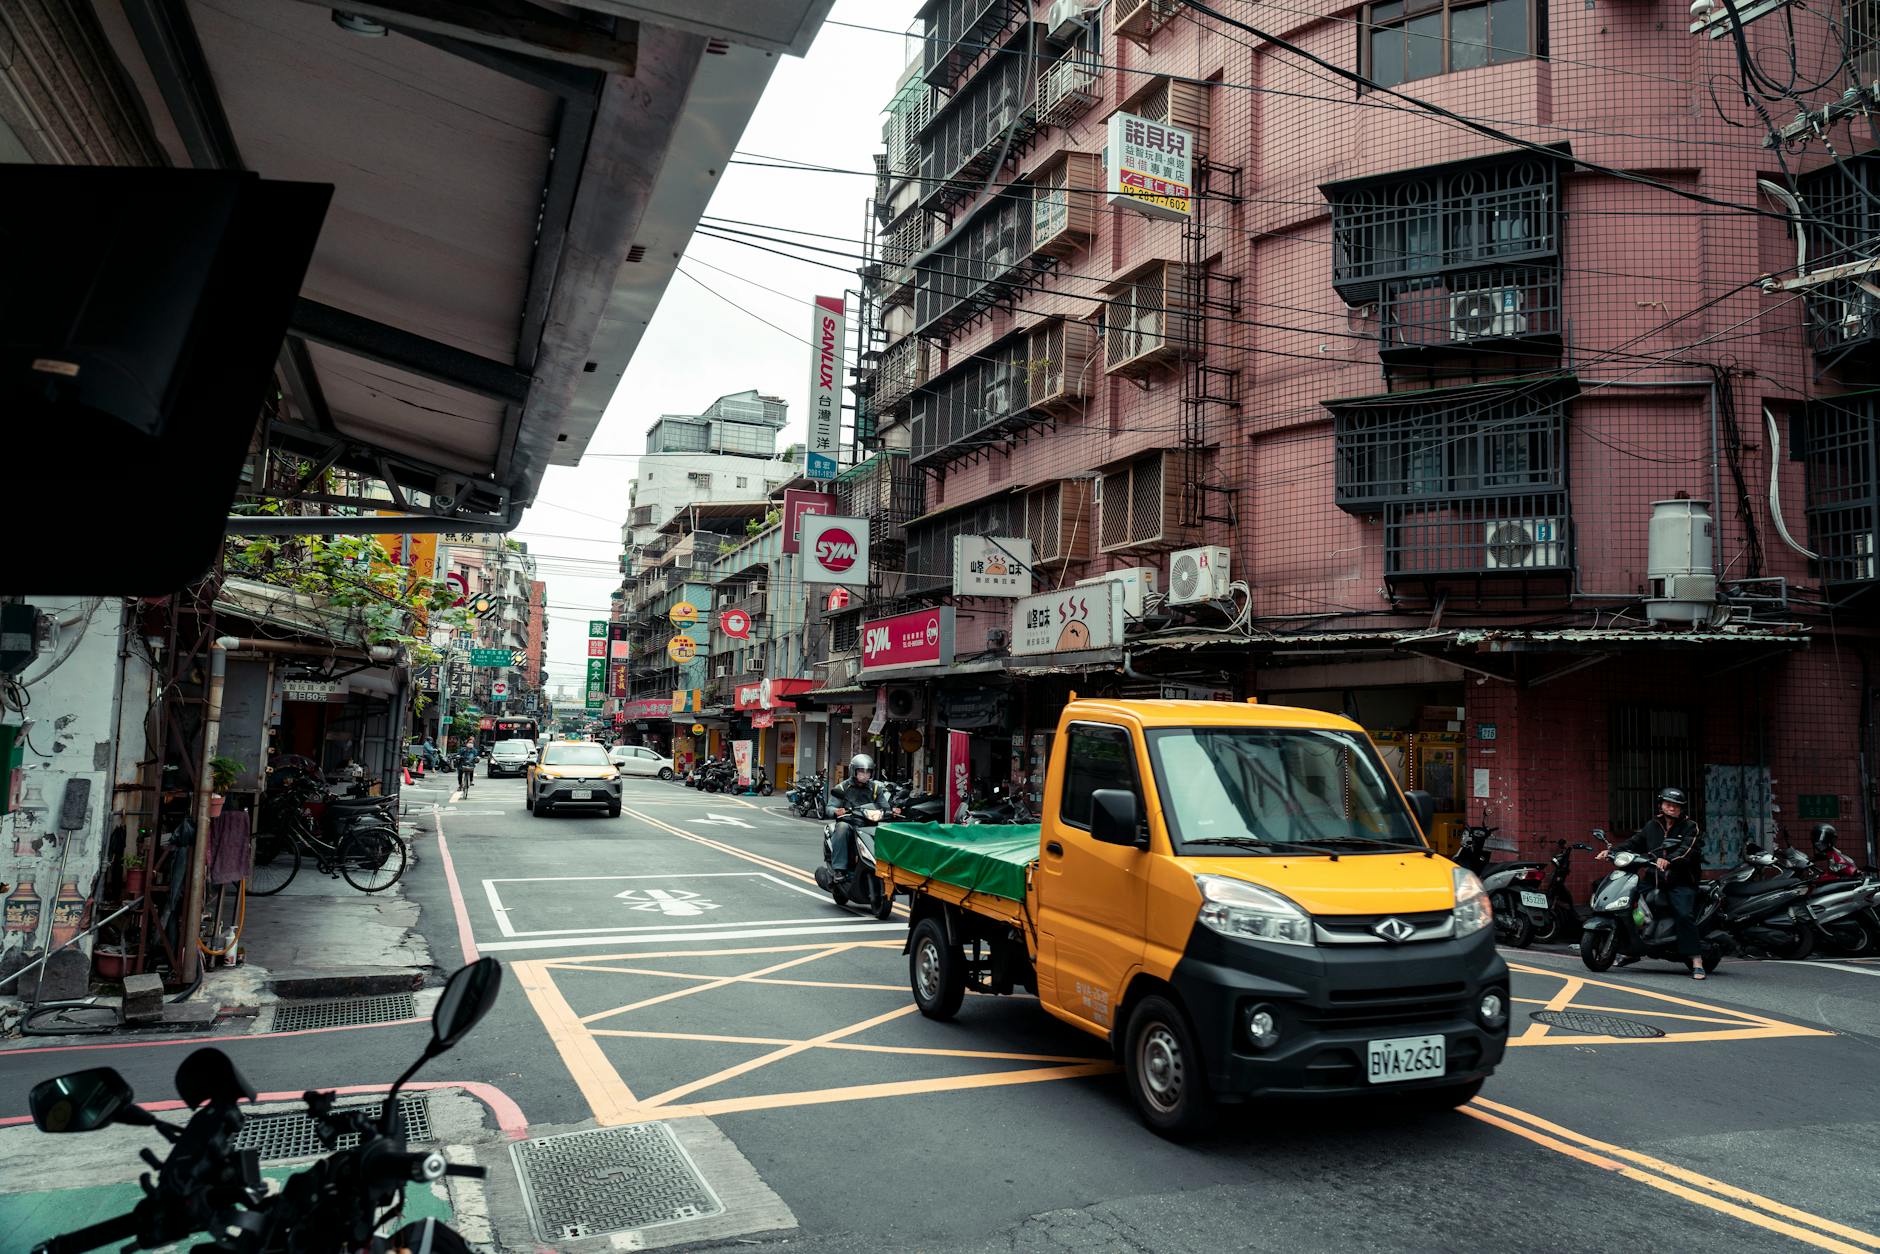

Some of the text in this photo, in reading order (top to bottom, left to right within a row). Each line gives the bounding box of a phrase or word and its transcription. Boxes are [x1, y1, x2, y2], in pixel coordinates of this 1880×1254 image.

[1125, 119, 1185, 158] 諾貝兒
[1125, 155, 1185, 182] 租借專賣店
[820, 316, 835, 391] SANLUX
[817, 394, 832, 450] 台灣三洋
[816, 541, 858, 563] SYM
[1026, 606, 1050, 629] 峰味
[865, 626, 891, 659] SYM
[1371, 1045, 1443, 1075] BVA-2630
